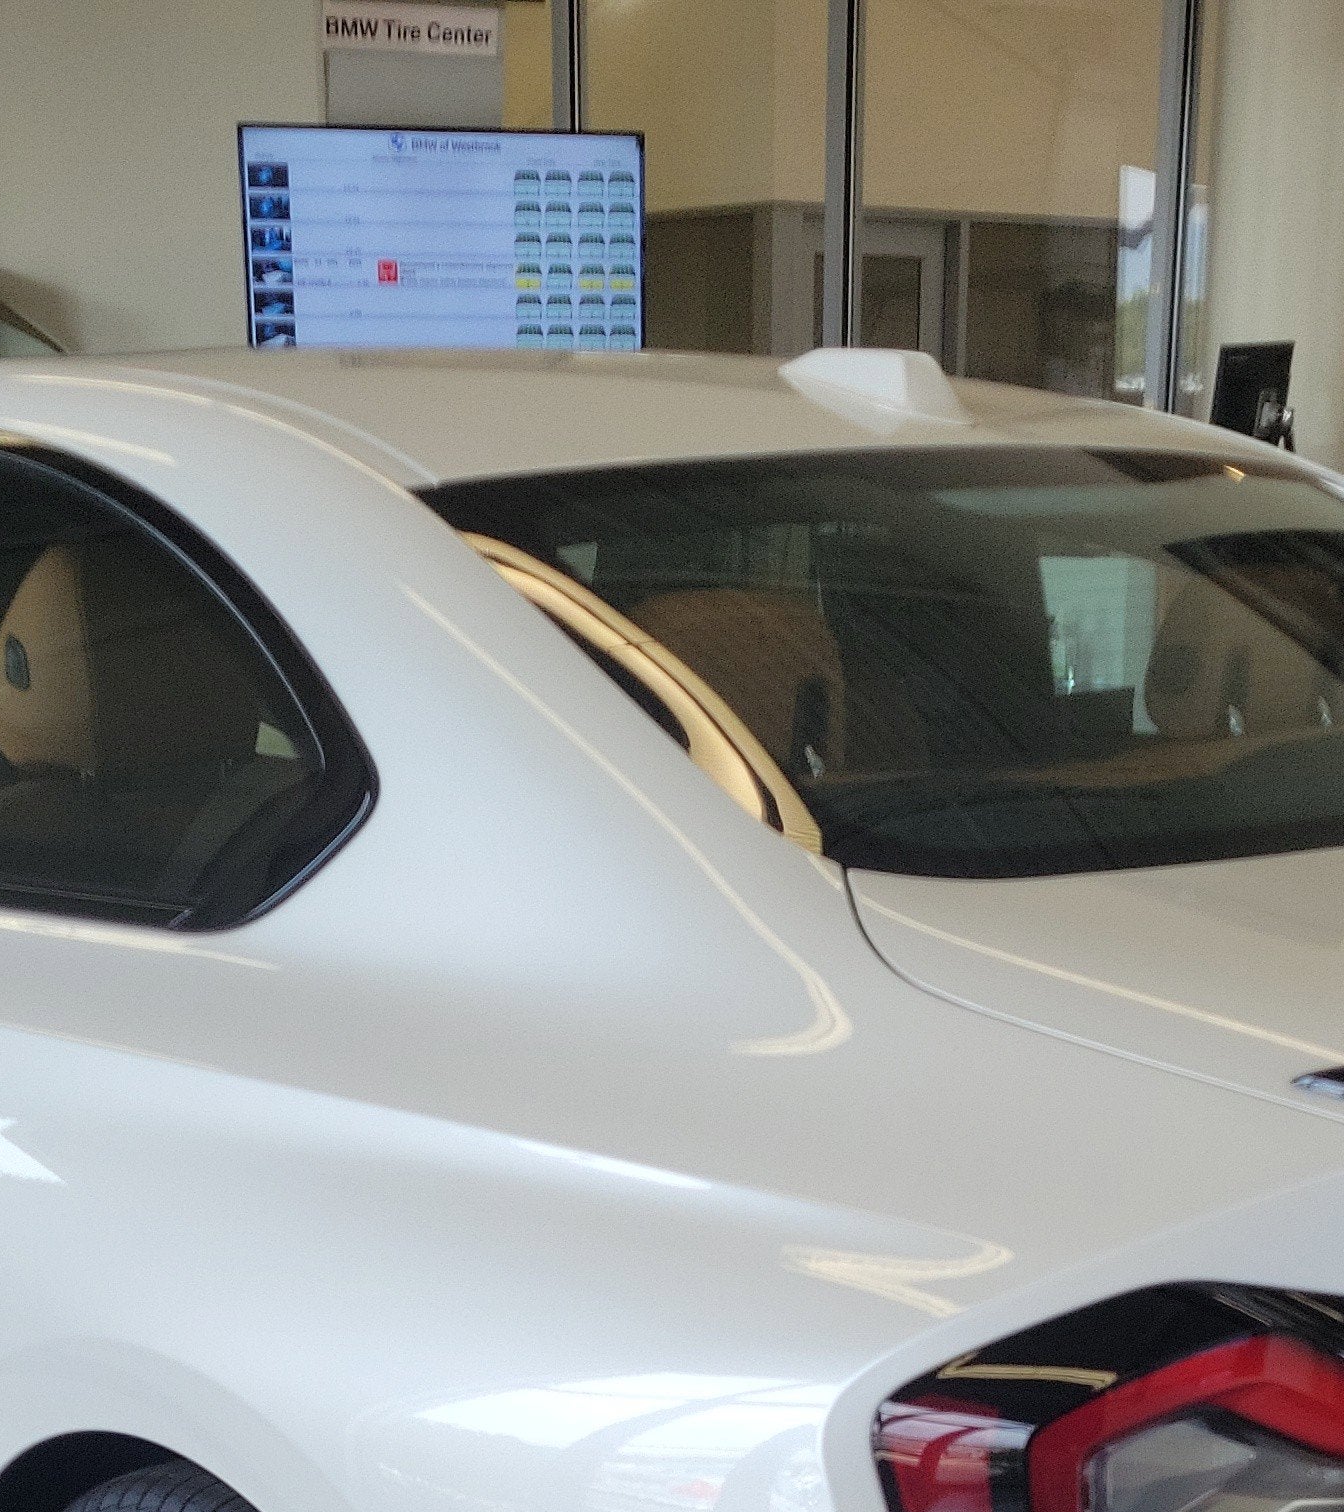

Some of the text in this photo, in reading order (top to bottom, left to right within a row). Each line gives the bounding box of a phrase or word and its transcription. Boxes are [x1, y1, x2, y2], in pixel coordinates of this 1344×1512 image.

[325, 15, 492, 46] BMW Tire Center
